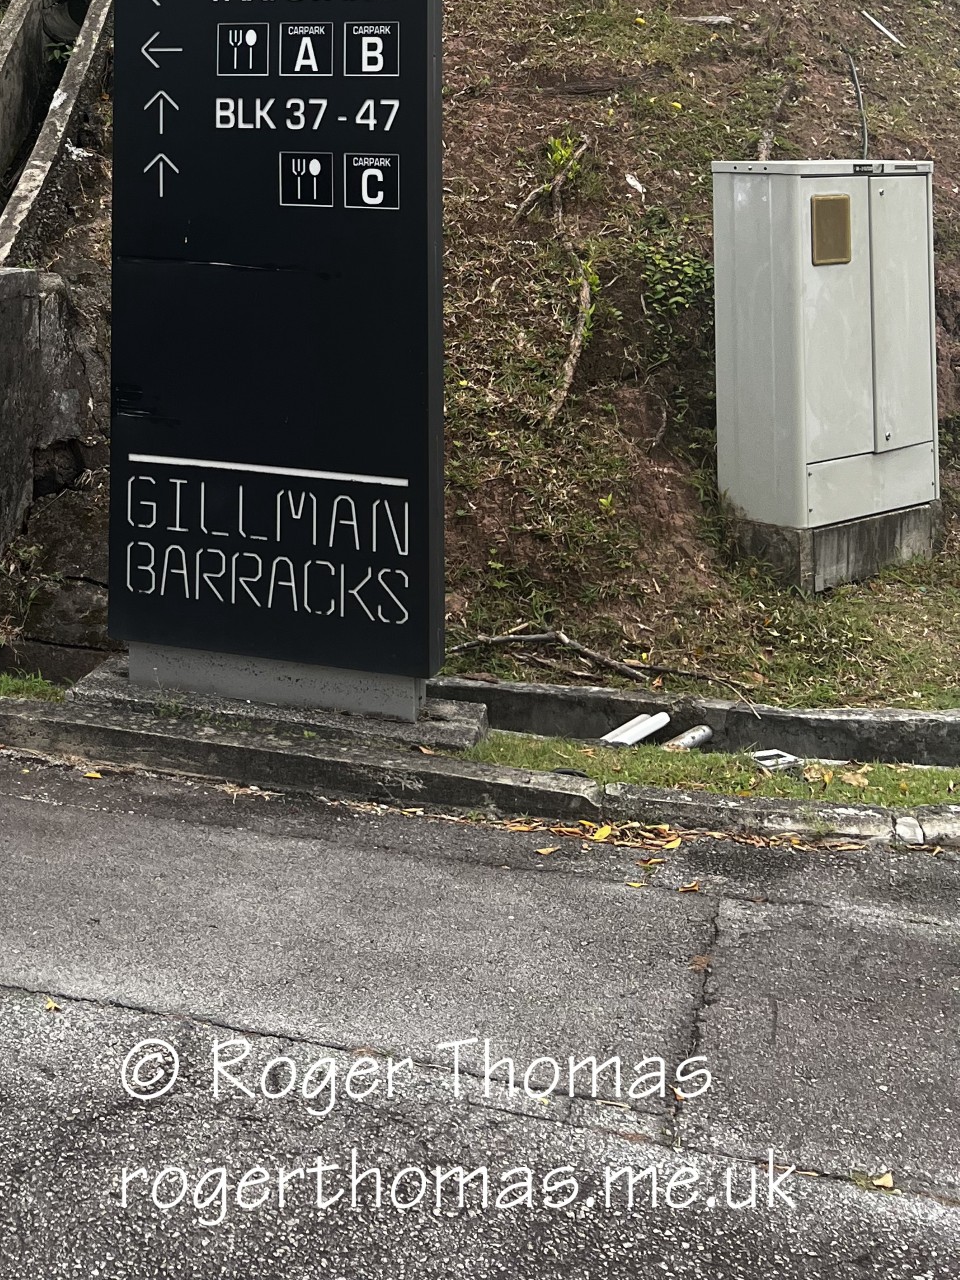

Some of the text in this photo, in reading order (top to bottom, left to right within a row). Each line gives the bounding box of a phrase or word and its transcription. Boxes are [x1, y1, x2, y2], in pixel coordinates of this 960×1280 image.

[287, 25, 326, 35] CARPARK
[352, 24, 391, 35] CARPARK
[294, 36, 319, 72] A
[361, 36, 384, 73] B
[215, 97, 277, 130] BLK
[285, 97, 328, 131] 37
[355, 97, 400, 132] 47
[352, 156, 391, 168] CARPARK
[361, 168, 384, 205] C
[126, 475, 410, 557] GILLMAN
[126, 541, 409, 625] BARRACKS
